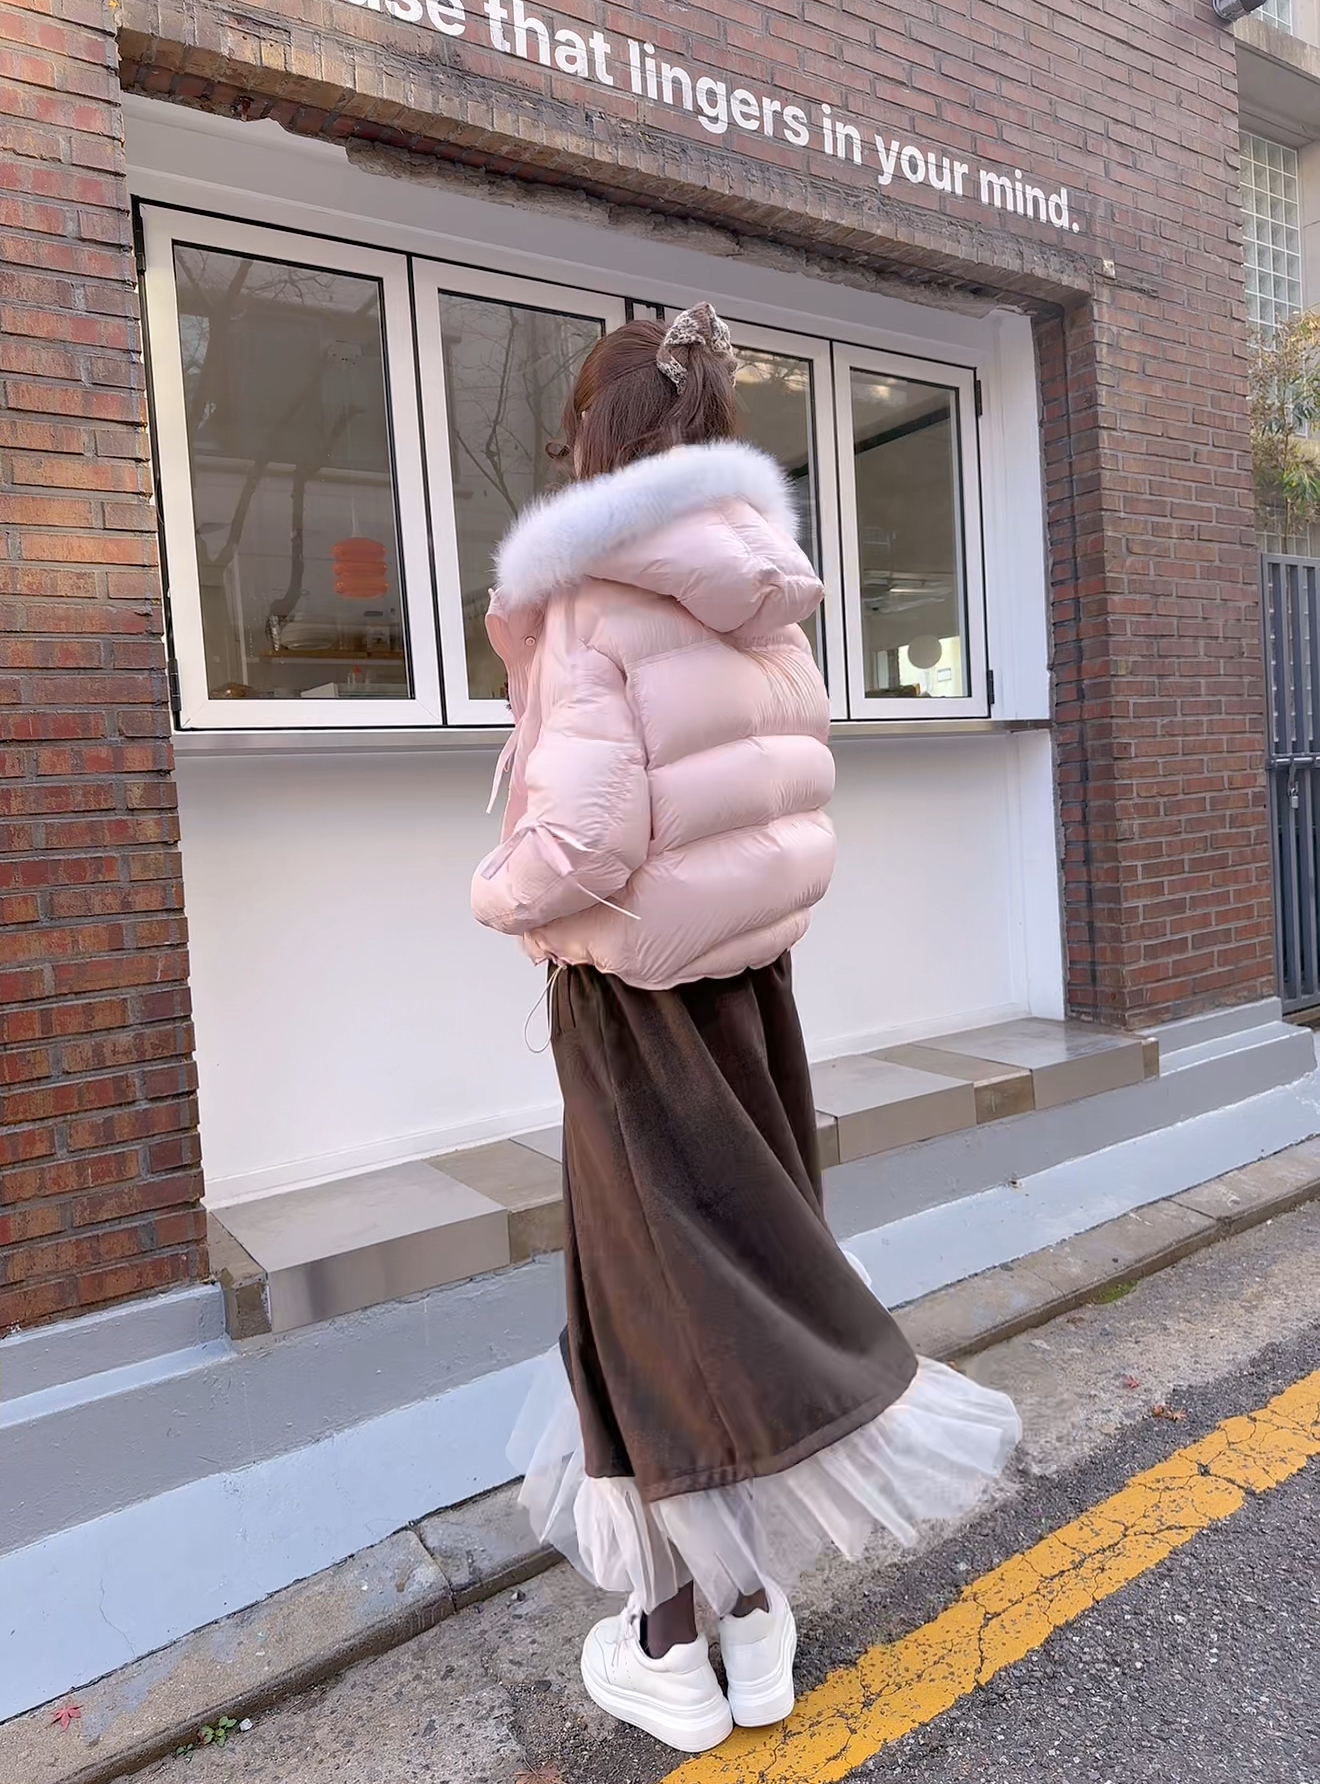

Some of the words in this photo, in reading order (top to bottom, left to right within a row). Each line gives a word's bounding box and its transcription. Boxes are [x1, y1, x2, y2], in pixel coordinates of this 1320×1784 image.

[484, 0, 614, 86] that
[627, 38, 810, 147] lingers
[821, 103, 862, 166] in
[874, 133, 969, 197] your
[979, 168, 1081, 233] mind.
